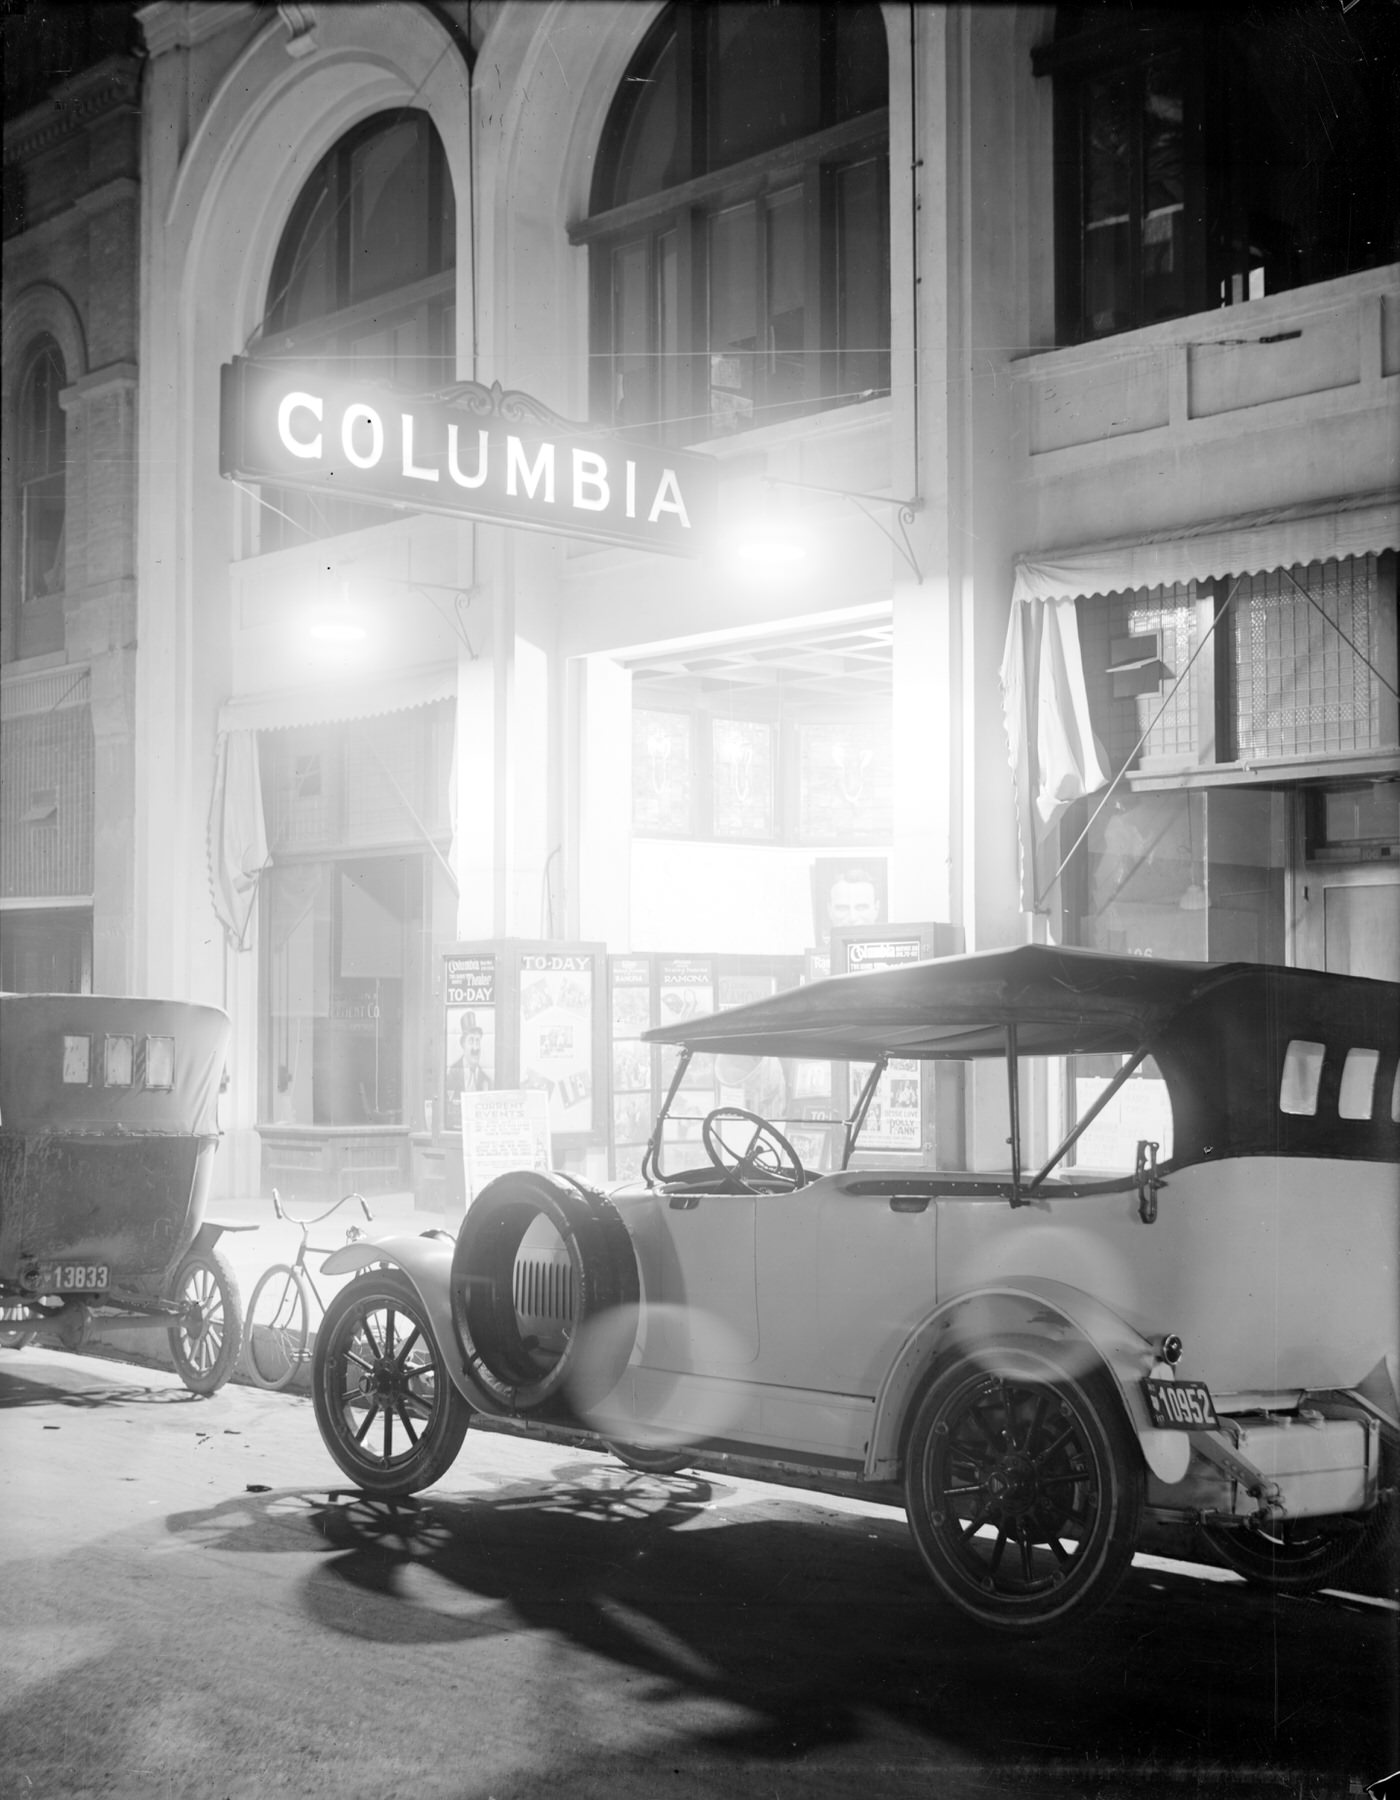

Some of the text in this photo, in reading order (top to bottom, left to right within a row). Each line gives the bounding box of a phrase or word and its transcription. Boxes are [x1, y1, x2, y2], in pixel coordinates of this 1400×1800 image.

[277, 390, 691, 528] COLUMBIA
[448, 960, 480, 973] Columbia
[664, 975, 709, 984] RAMONA
[474, 1102, 525, 1110] CURRENT
[474, 1110, 525, 1118] EVENTS
[54, 1266, 108, 1288] 13833
[1158, 1385, 1217, 1424] 10952
